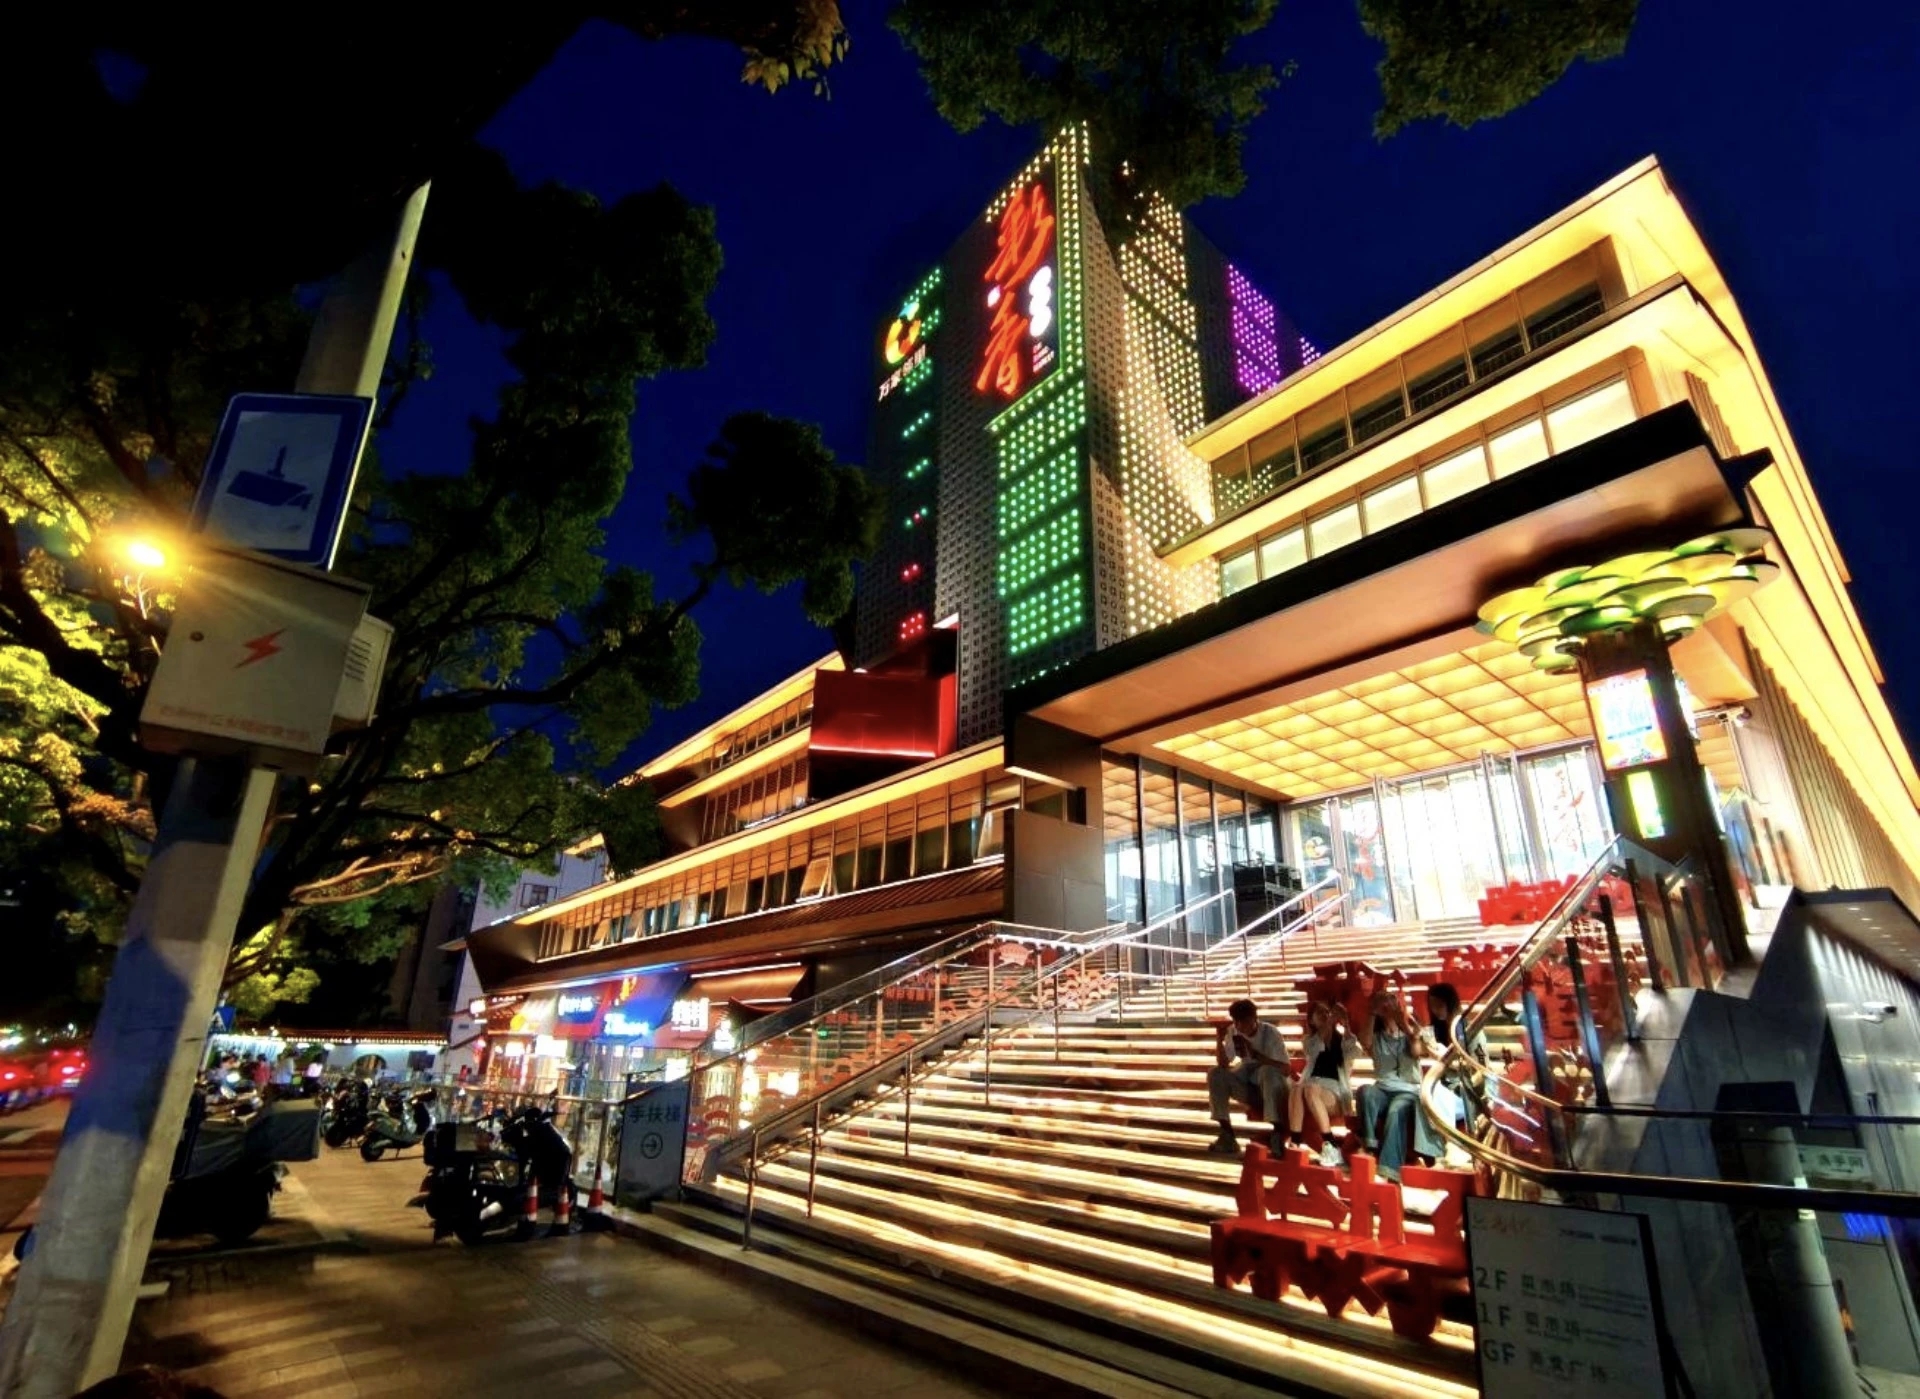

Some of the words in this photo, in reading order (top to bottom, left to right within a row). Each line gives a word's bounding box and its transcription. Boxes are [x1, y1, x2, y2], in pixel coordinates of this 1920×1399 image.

[1475, 1266, 1507, 1291] 2F
[1477, 1302, 1511, 1327] 1F
[1482, 1339, 1516, 1364] GF
